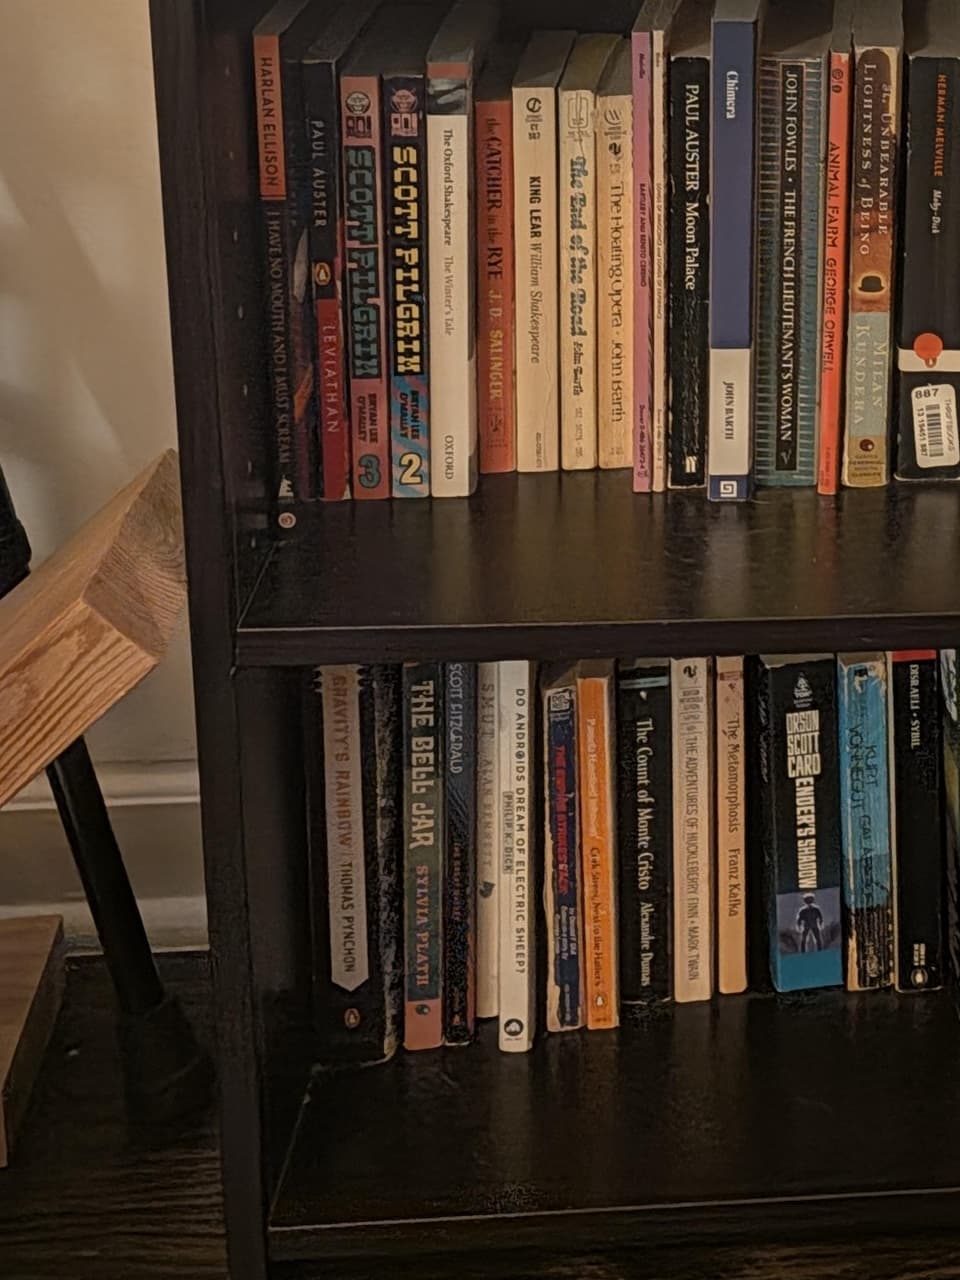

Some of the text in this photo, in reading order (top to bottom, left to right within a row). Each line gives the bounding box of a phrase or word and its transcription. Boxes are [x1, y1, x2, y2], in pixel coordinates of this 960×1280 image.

[260, 57, 279, 187] HARLAN ELLISON
[311, 120, 328, 227] PAUL AUSTER
[684, 84, 700, 290] PAUL AUSTER Moon Palace
[394, 145, 421, 372] SCOTT PILGRIM
[779, 70, 799, 441] JOHN FOWLES THE FRENCH LIEUTENANT'S WOMAN
[321, 325, 339, 434] LEVIATHAN
[409, 680, 435, 986] THE BELL JAR SYLVIA PLATH
[722, 718, 741, 917] The Metamorphosis Franz Kafka
[795, 780, 817, 889] ENDER'S SHADOW
[339, 860, 357, 973] THOMAS PYNCHON
